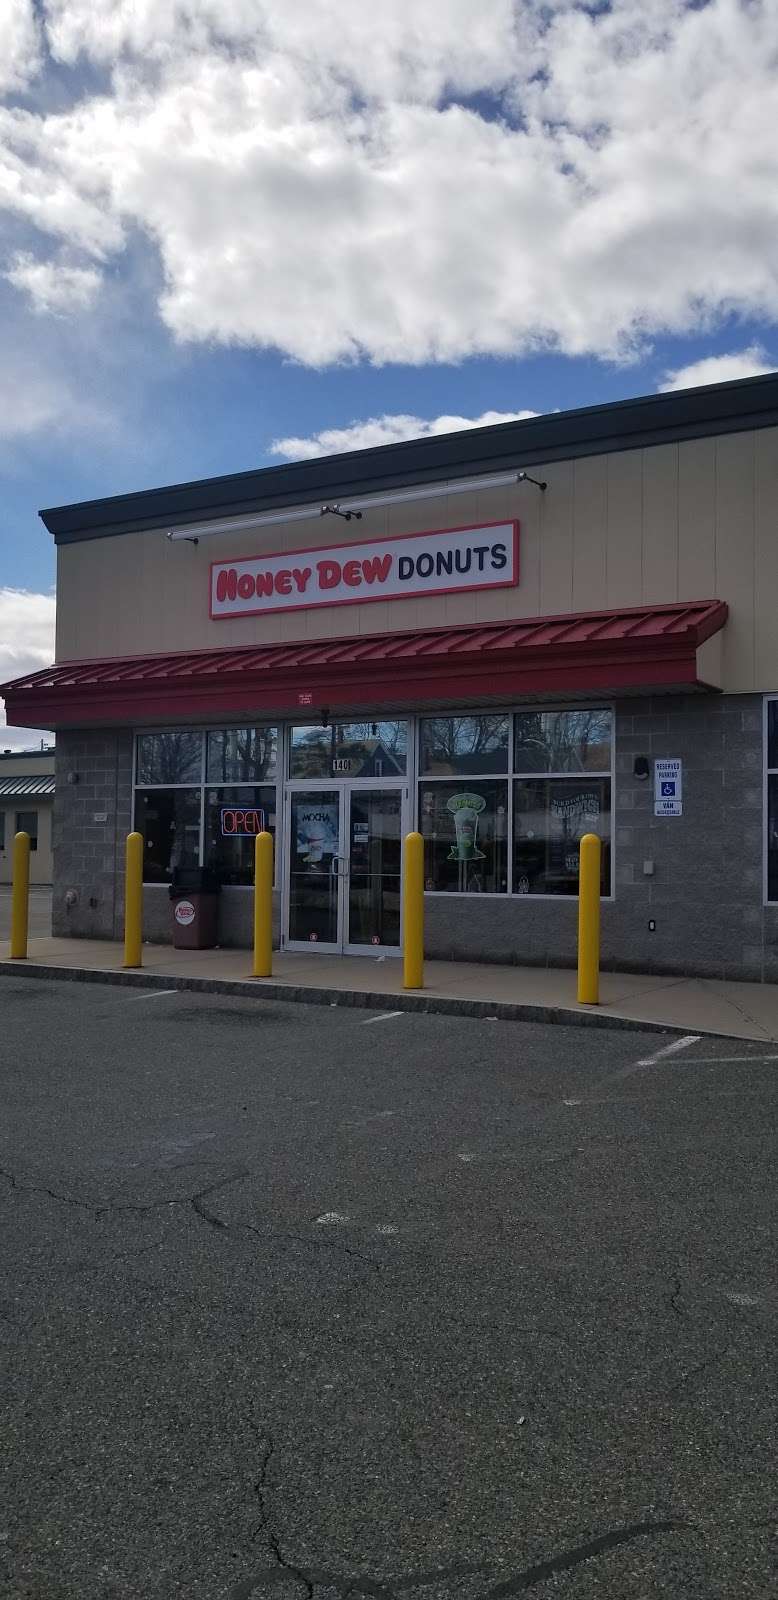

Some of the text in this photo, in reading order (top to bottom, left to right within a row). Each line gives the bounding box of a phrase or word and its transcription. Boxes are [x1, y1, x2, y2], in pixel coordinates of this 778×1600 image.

[215, 543, 508, 602] HONEY DEW DONUTS
[223, 810, 263, 833] OPEN
[302, 812, 330, 823] MOCHA
